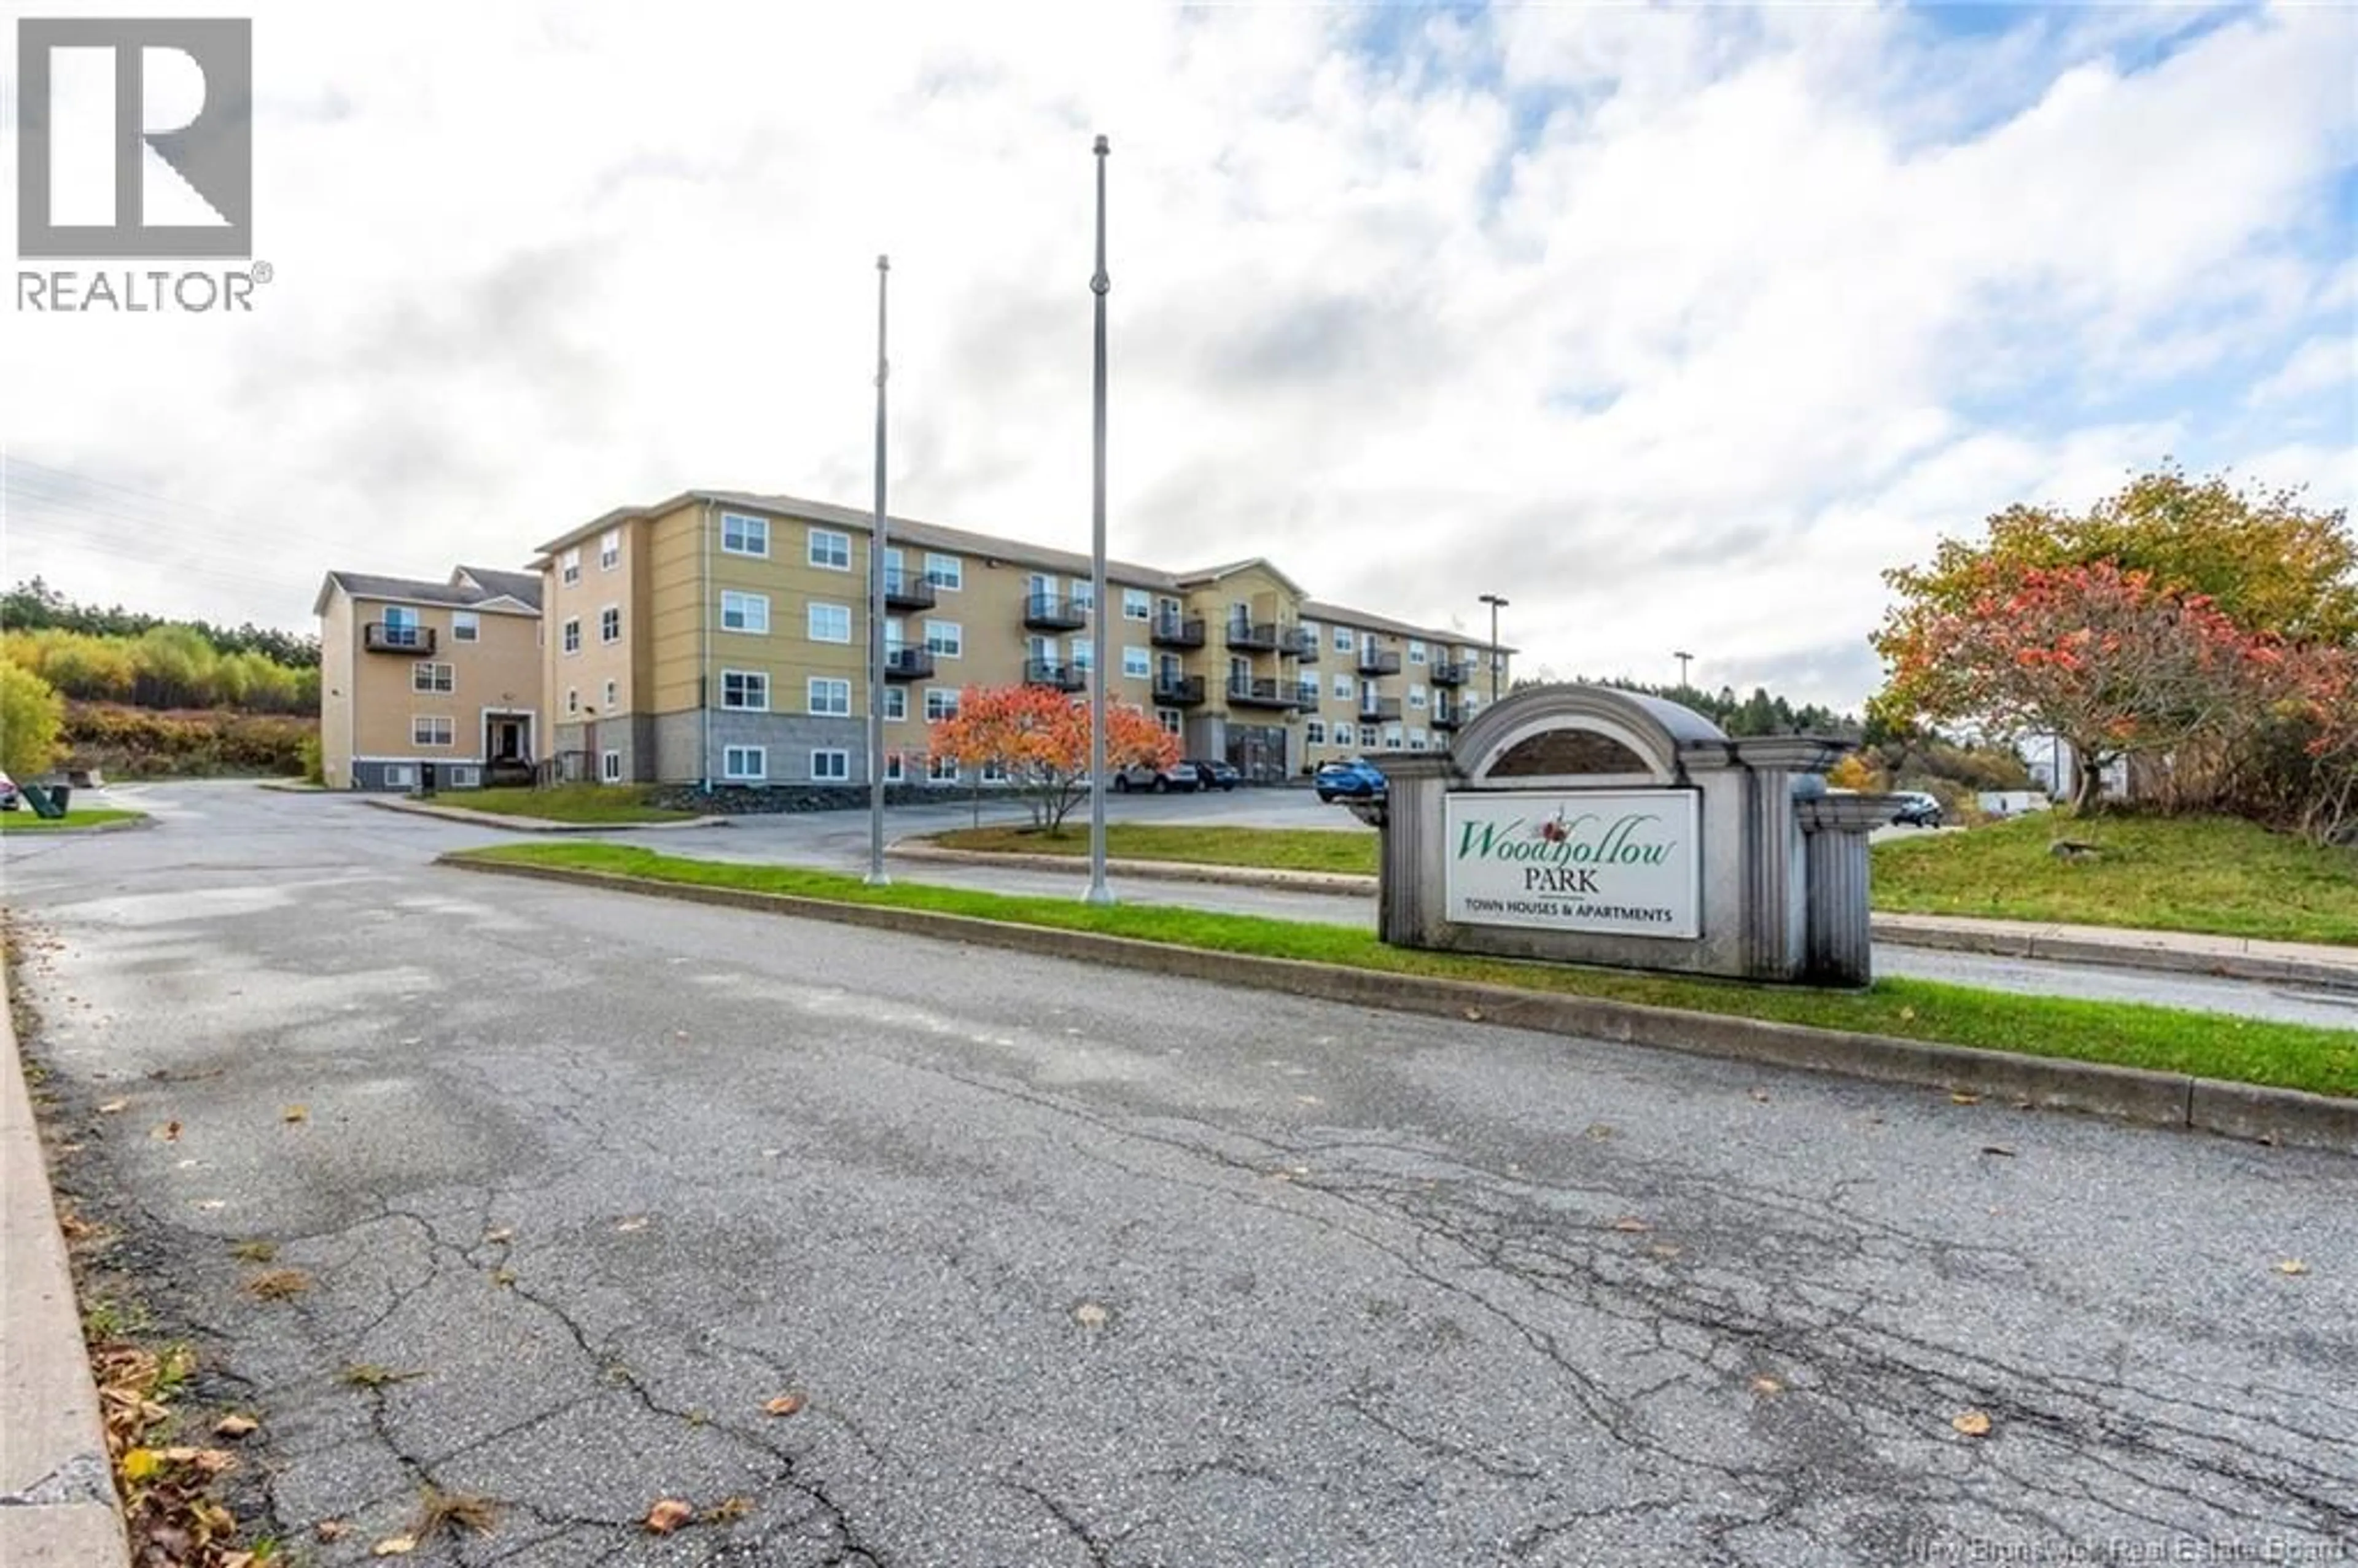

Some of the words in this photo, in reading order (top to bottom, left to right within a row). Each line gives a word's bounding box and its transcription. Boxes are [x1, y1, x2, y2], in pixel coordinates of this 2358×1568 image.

[1457, 813, 1677, 868] Woodhollow
[1525, 867, 1599, 893] PARK
[1465, 898, 1505, 912] TOWN
[1507, 901, 1558, 916] HOUSES
[1562, 904, 1572, 915] &
[1576, 906, 1673, 922] APARTMENTS
